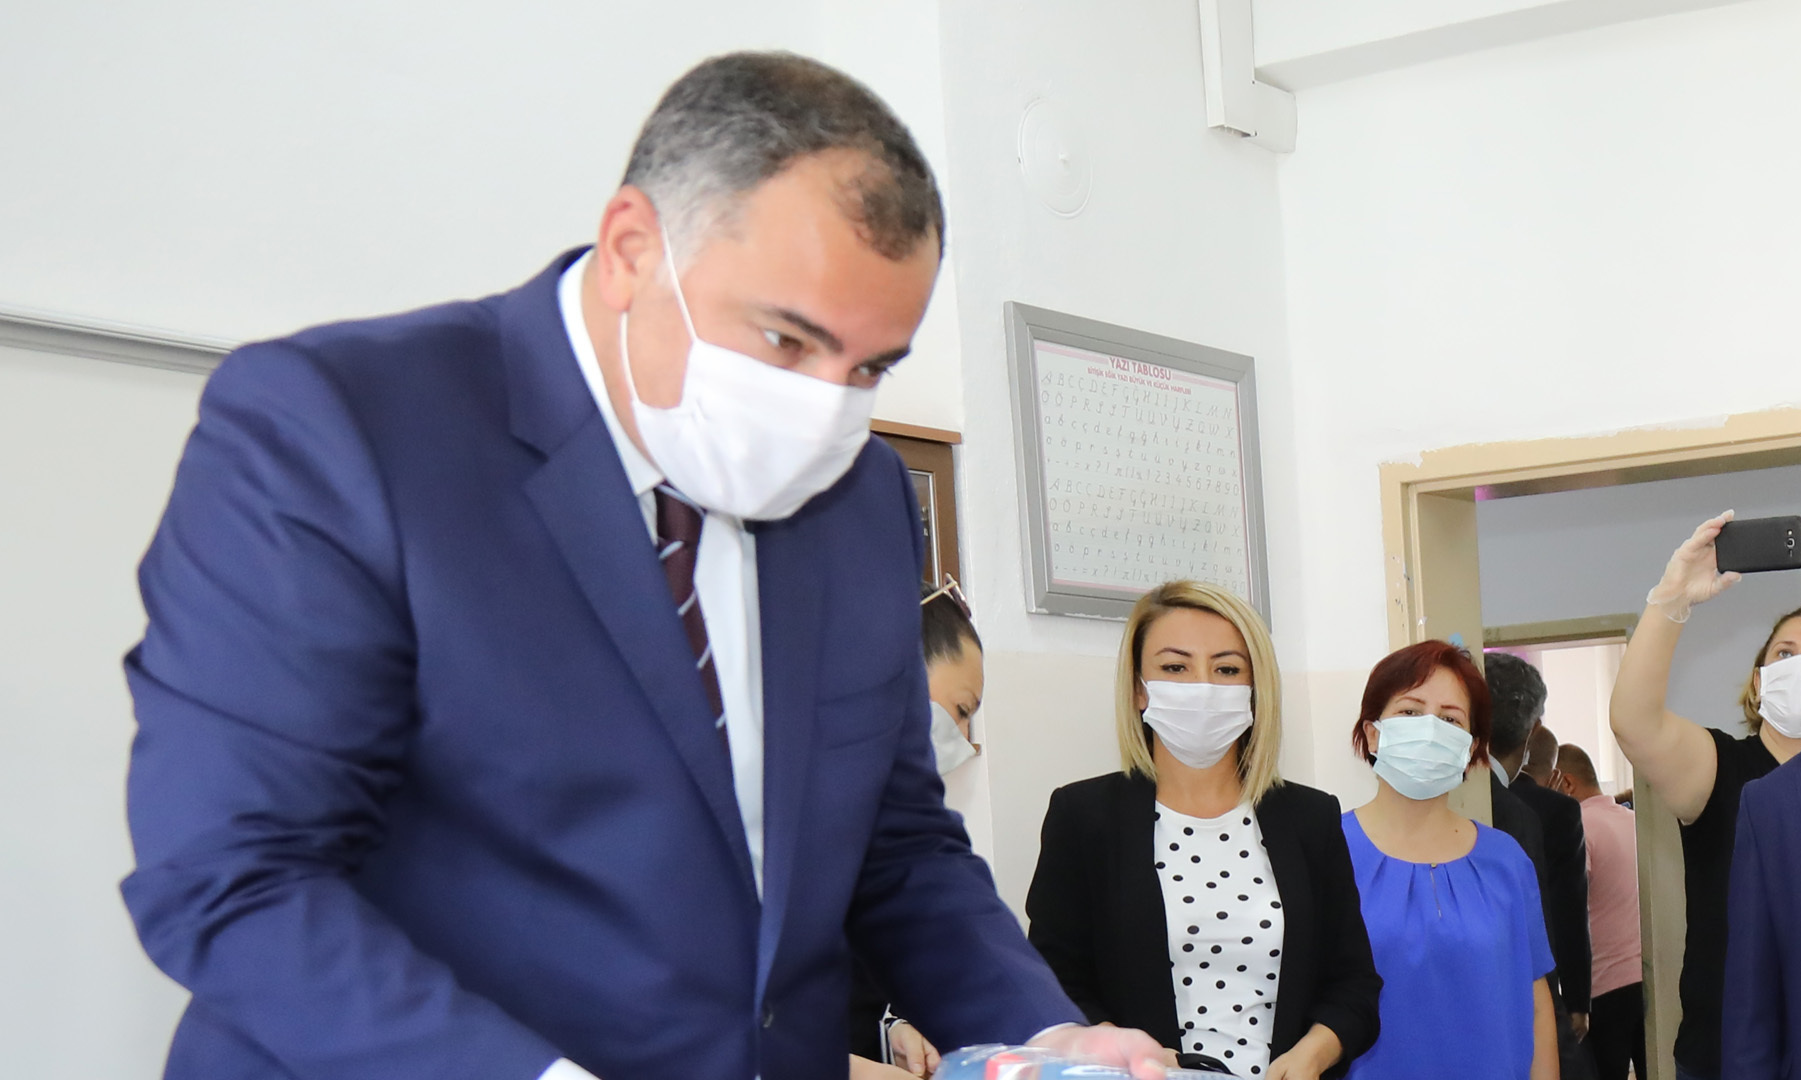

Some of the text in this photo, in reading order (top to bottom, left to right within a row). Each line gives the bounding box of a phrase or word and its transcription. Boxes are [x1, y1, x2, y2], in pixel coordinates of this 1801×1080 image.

[1109, 357, 1171, 380] YAZI TABLOSU
[1118, 374, 1128, 382] YAZI
[1129, 376, 1145, 385] BÜYÜK
[1154, 382, 1169, 390] KÜÇÜK
